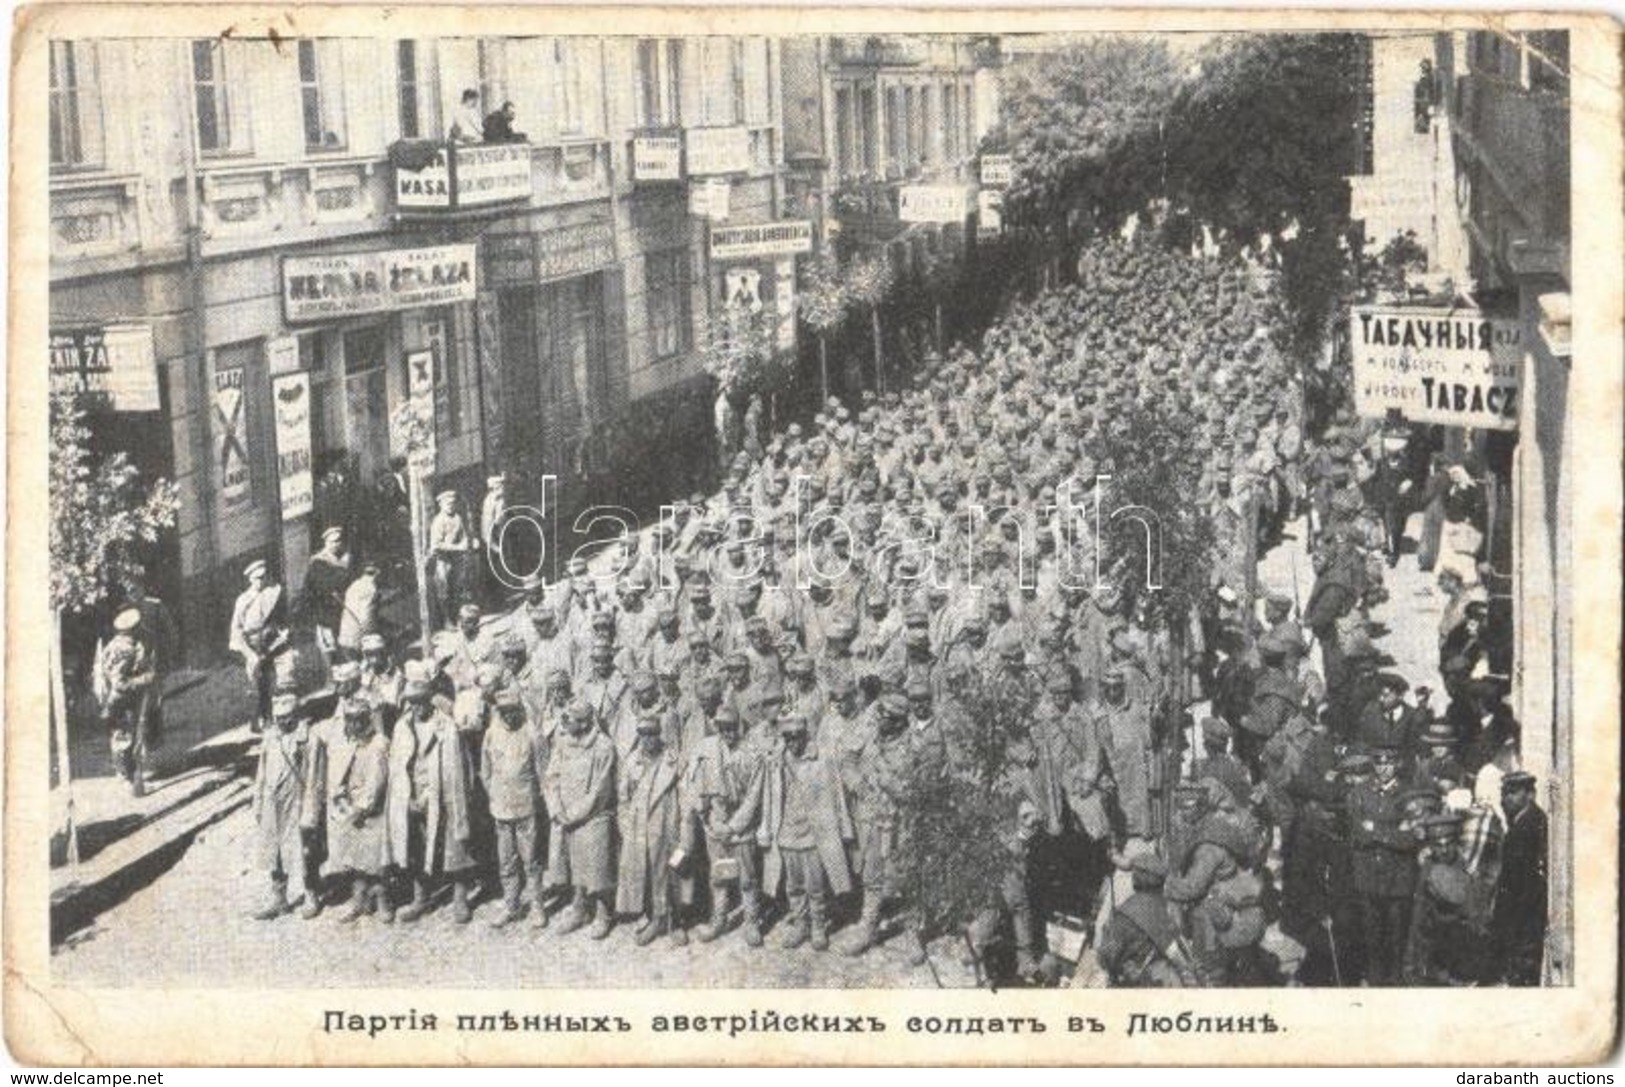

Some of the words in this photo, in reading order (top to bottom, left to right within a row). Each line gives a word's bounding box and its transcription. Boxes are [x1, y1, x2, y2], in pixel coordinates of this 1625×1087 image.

[401, 179, 447, 196] KASA
[1359, 313, 1494, 351] ТАБАЧНЫЯ
[1421, 377, 1518, 417] TABACZ
[325, 1010, 436, 1037] Партія
[459, 1012, 630, 1031] плѣнныхъ
[653, 1011, 885, 1036] австрійскихъ
[908, 1018, 1045, 1034] солдатъ
[1069, 1018, 1104, 1032] въ
